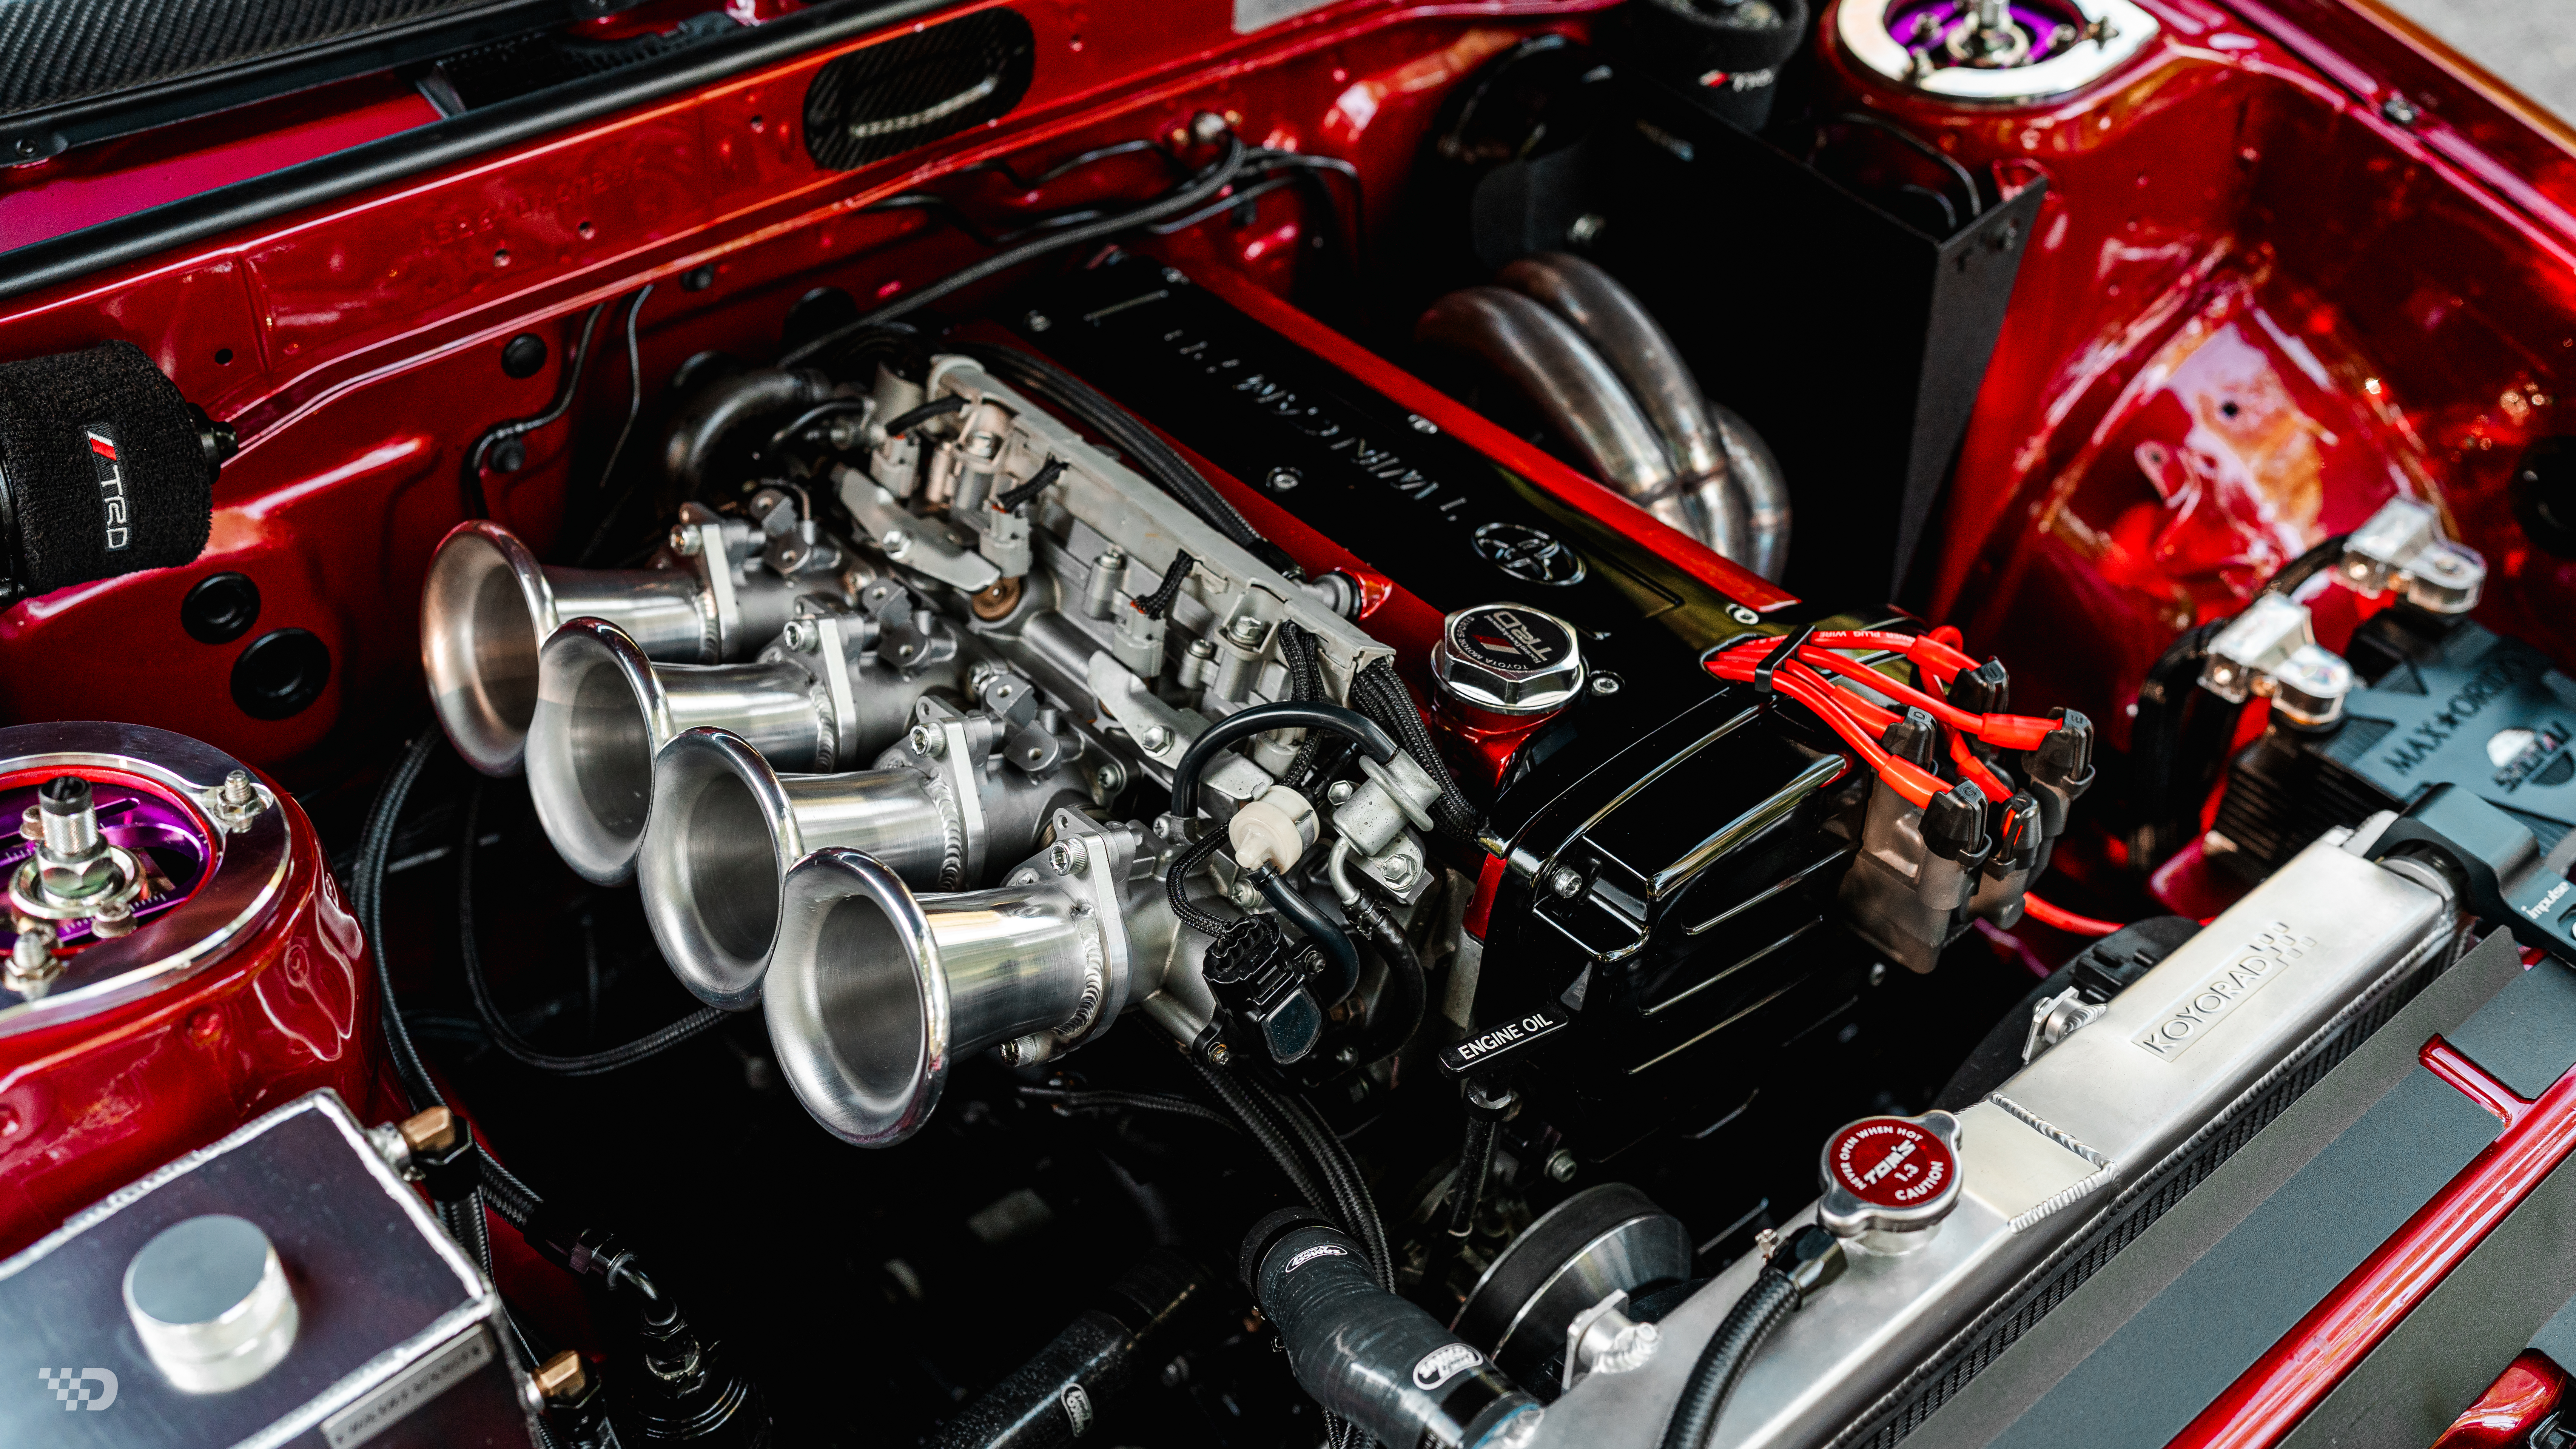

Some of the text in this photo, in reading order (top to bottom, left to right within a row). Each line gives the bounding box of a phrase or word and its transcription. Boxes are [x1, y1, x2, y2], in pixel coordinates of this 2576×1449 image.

[101, 464, 127, 548] TRD
[1458, 639, 1483, 660] MOTOR
[1493, 611, 1552, 661] TRD
[1486, 658, 1528, 670] TOYOTA
[2521, 882, 2570, 920] impulse
[2143, 956, 2273, 1054] KOYORAD
[1458, 1013, 1554, 1060] ENGINE OIL
[1839, 1125, 1924, 1190] NEVER OPEN WHEN HOT
[1863, 1139, 1916, 1185] TOM'S
[1894, 1163, 1919, 1182] 1.3
[1895, 1161, 1944, 1201] CAUTION
